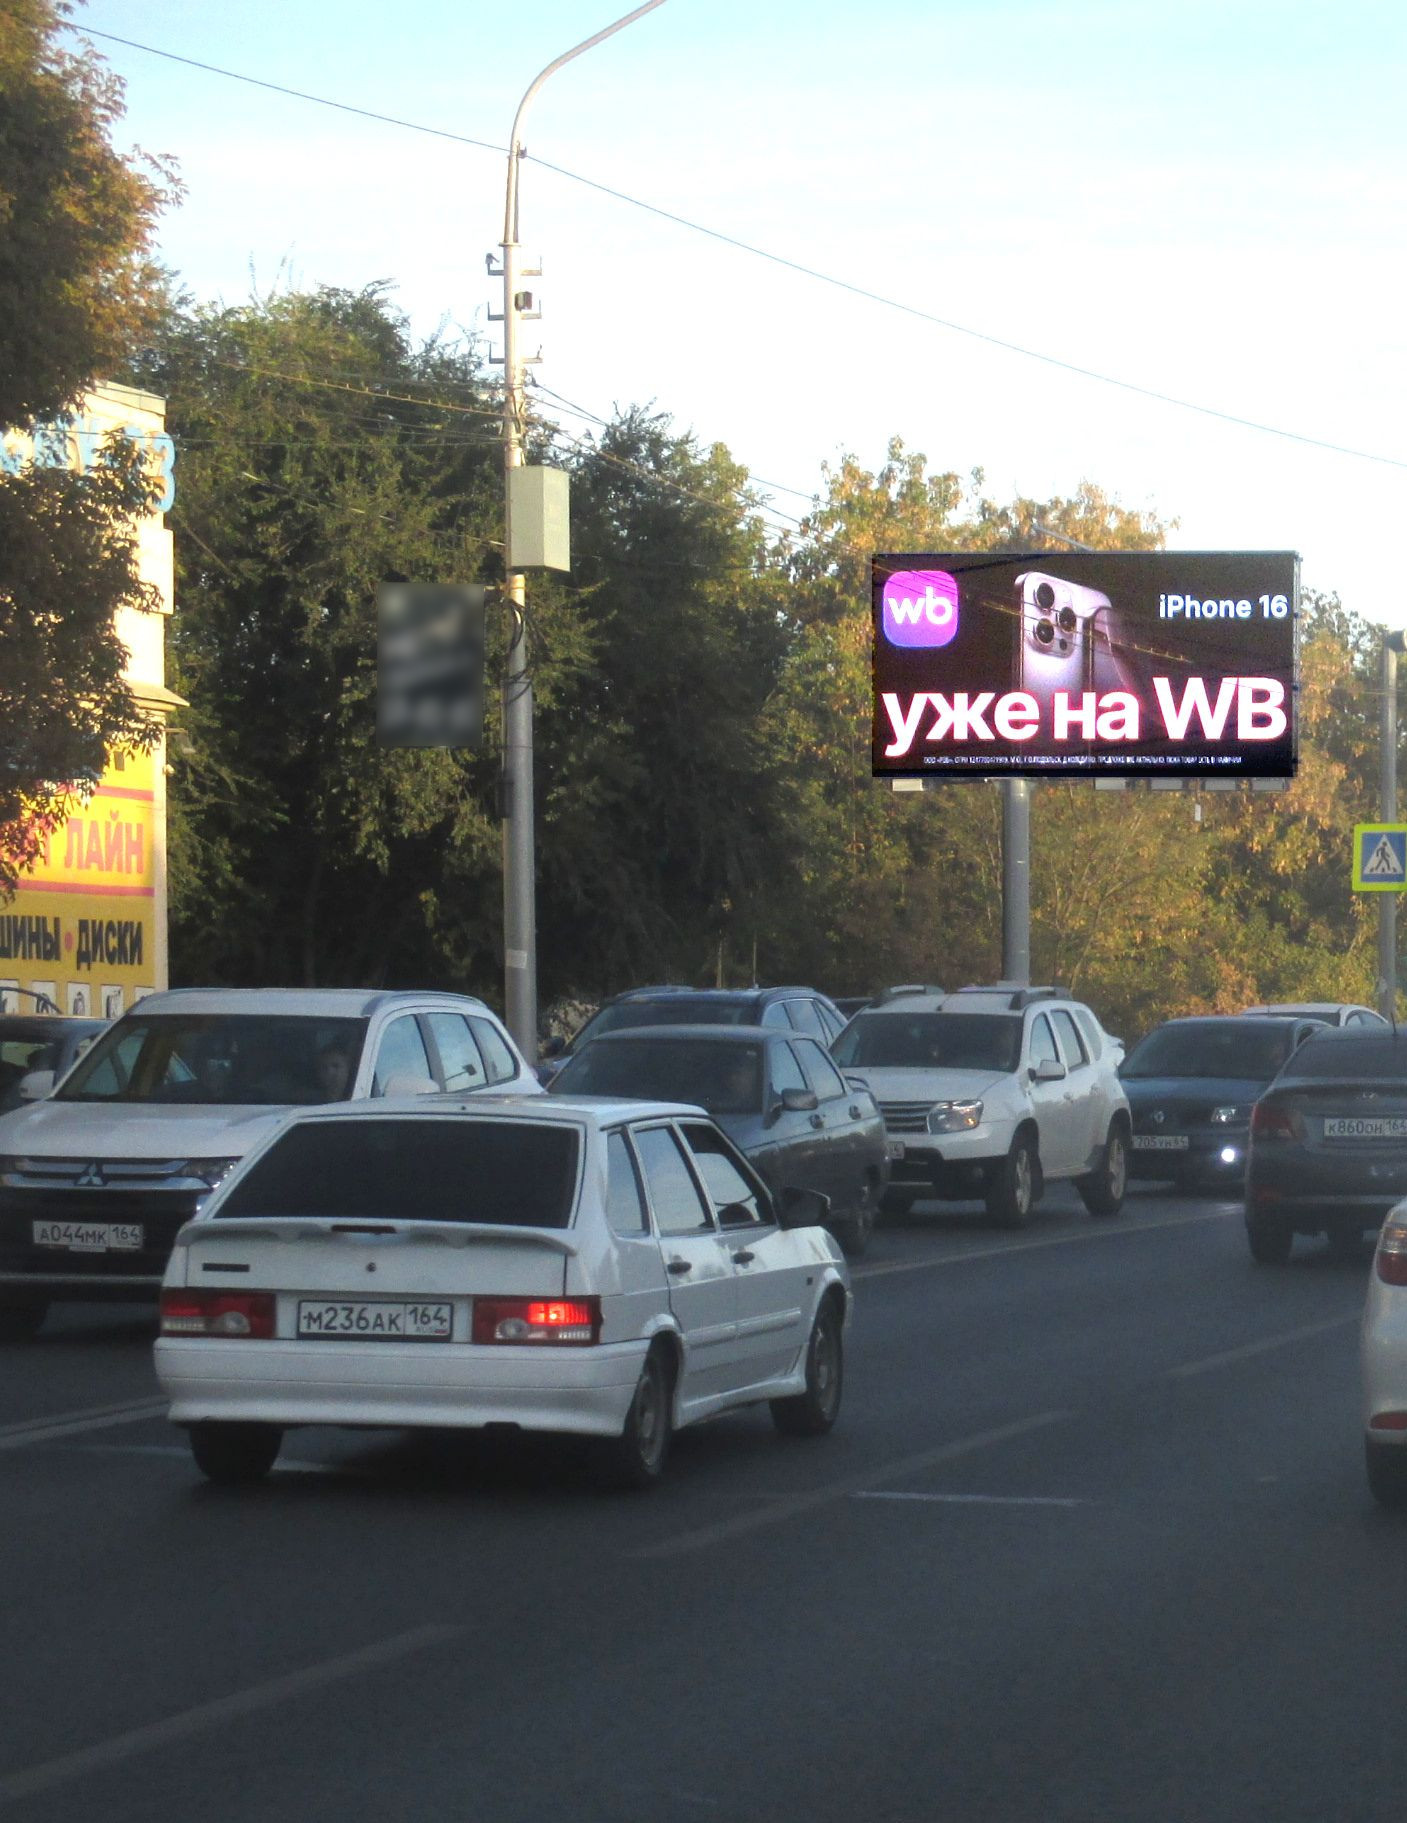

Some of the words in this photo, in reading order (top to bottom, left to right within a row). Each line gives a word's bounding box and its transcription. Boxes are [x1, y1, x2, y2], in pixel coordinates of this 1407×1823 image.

[887, 585, 953, 625] wb
[1159, 594, 1252, 618] iPhone
[1258, 594, 1288, 618] 16
[881, 691, 1040, 757] уже
[1053, 691, 1140, 741] на
[1152, 676, 1288, 741] WB
[64, 809, 144, 874] ЛАЙН
[76, 919, 143, 971] ДИСКИ
[40, 1225, 106, 1244] А044МК
[111, 1226, 140, 1241] 164
[306, 1306, 402, 1332] М236АК
[408, 1306, 447, 1326] 164
